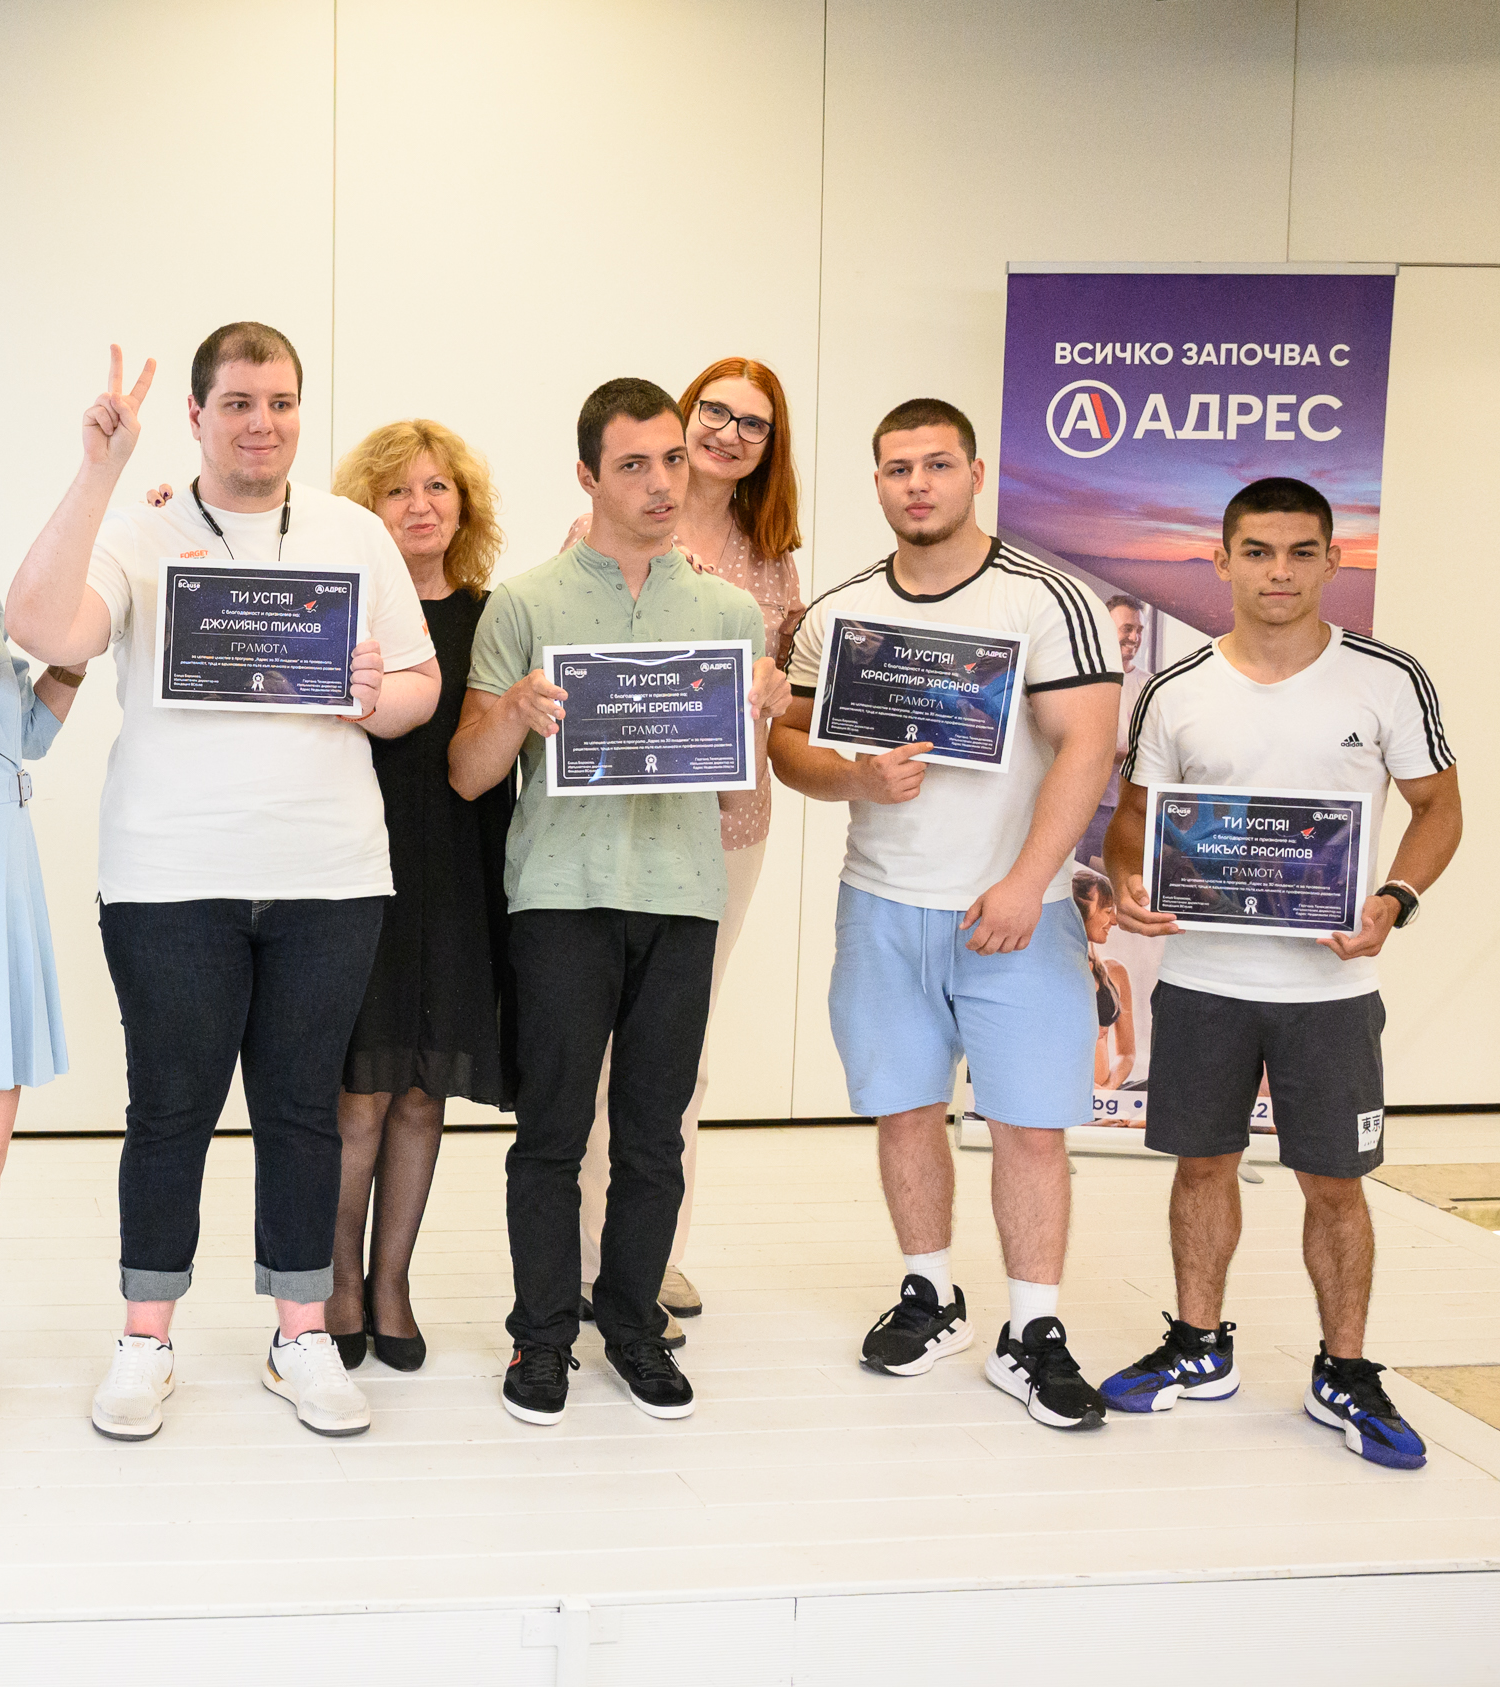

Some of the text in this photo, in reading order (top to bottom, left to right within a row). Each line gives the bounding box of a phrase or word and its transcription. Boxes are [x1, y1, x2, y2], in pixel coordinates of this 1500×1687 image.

[1054, 342, 1350, 367] ВСИЧКО ЗАПОЧВА С
[1133, 393, 1344, 442] АДРЕС
[180, 550, 208, 559] FORGET
[230, 590, 293, 605] ТИ УСПЯ!
[200, 618, 321, 633] ДЖУЛИЯНО МИЛКОВ
[230, 641, 288, 653] ГРАМОТА
[985, 650, 1007, 658] АДРЕС
[892, 646, 954, 665] ТИ УСПЯ!
[617, 672, 679, 686] ТИ УСПЯ!
[860, 668, 979, 693] КРАСИМИР ХАСАНОВ
[596, 700, 702, 714] МАРТИН ЕРЕМИЕВ
[888, 693, 944, 708] ГРАМОТА
[621, 723, 677, 735] ГРАМОТА
[1221, 816, 1289, 831] ТИ УСПЯ!
[1196, 842, 1312, 859] НИКЪЛС РАСИМОВ
[1222, 865, 1283, 878] ГРАМОТА
